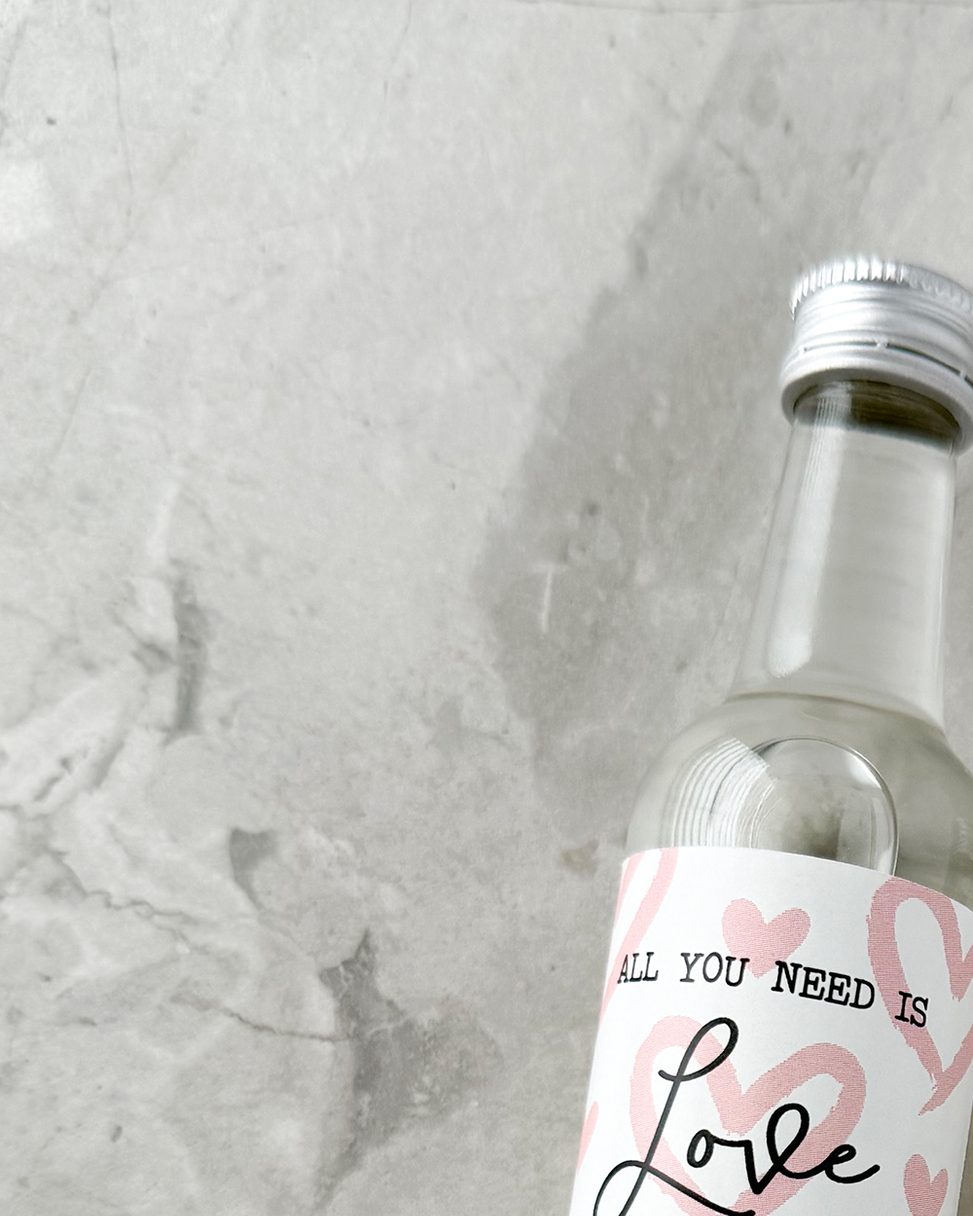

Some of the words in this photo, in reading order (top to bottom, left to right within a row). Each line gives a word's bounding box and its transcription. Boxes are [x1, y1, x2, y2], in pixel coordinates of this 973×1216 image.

[616, 951, 660, 984] ALL
[679, 951, 752, 988] YOU
[770, 960, 876, 1011] NEED
[893, 990, 930, 1028] IS
